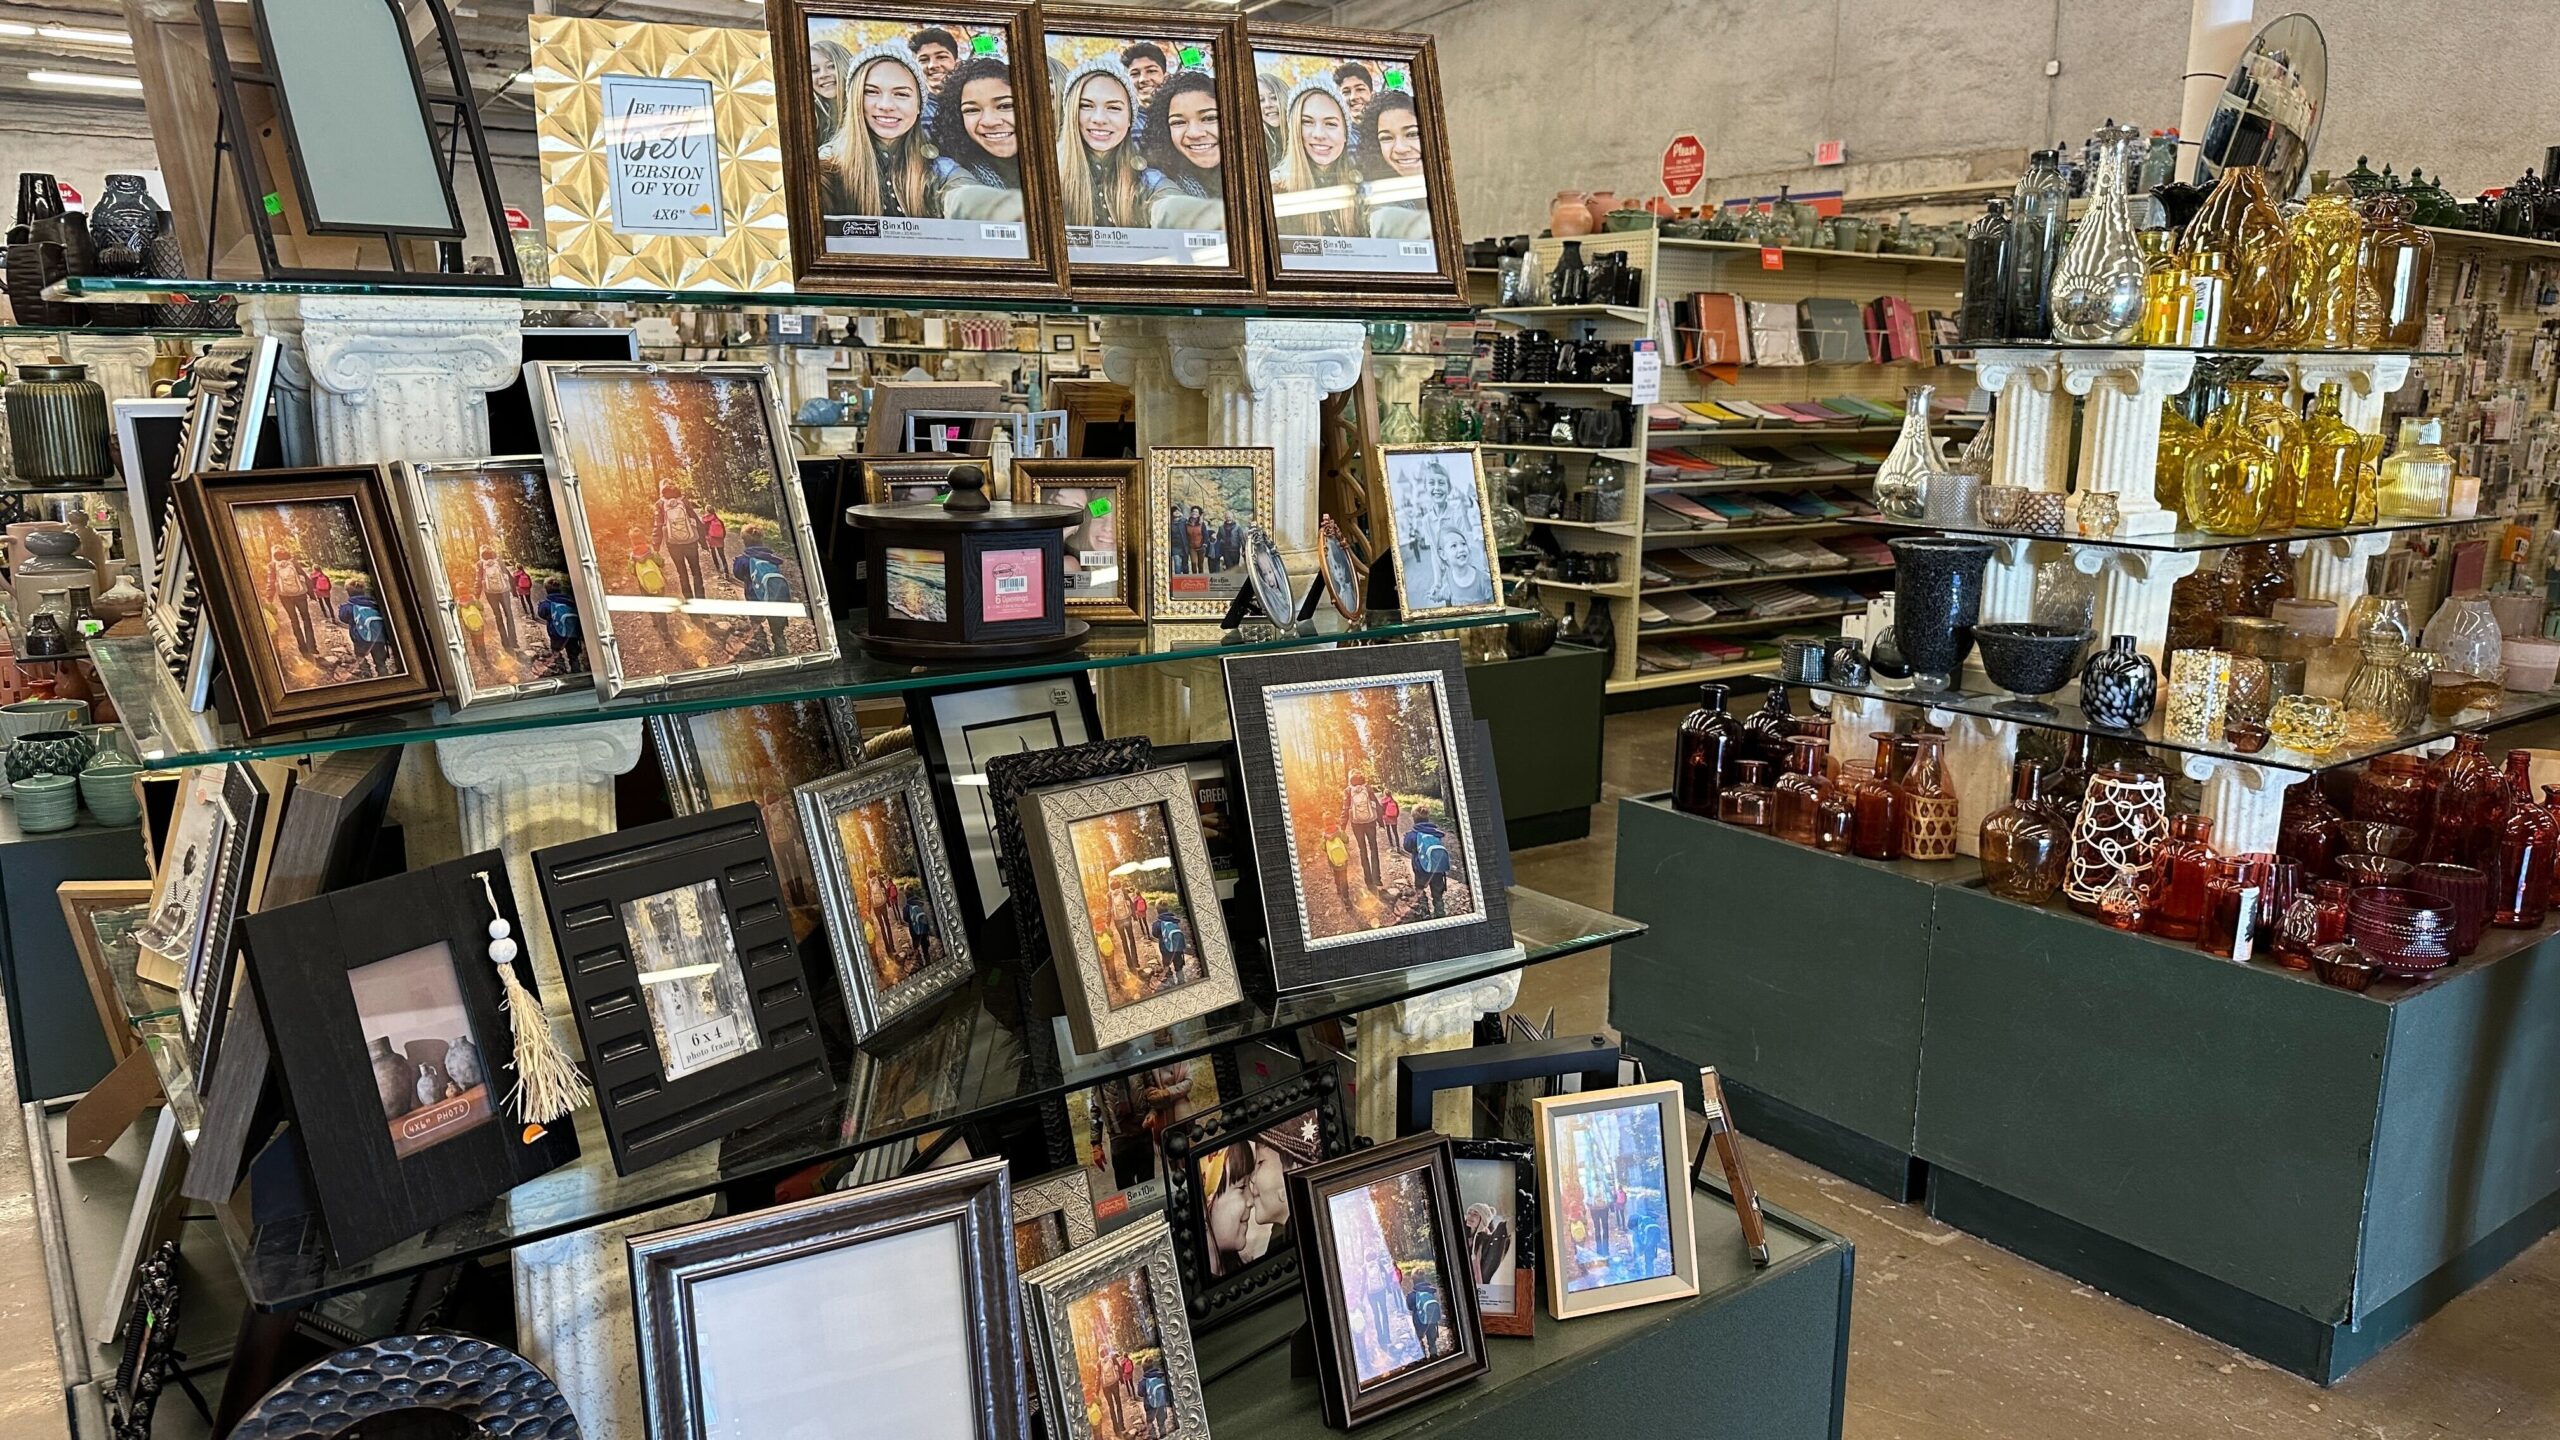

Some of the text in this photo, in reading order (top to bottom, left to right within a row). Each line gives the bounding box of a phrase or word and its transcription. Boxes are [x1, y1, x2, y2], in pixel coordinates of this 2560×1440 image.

[634, 103, 692, 115] BE THE
[1819, 142, 1840, 163] EXIT
[624, 164, 704, 180] VERSION
[631, 181, 700, 197] OF YOU
[995, 594, 1001, 605] 6
[1199, 787, 1228, 804] GREEN
[691, 1026, 722, 1047] 6 x 4
[686, 1039, 735, 1063] photo frame
[436, 1104, 465, 1123] PHOTO
